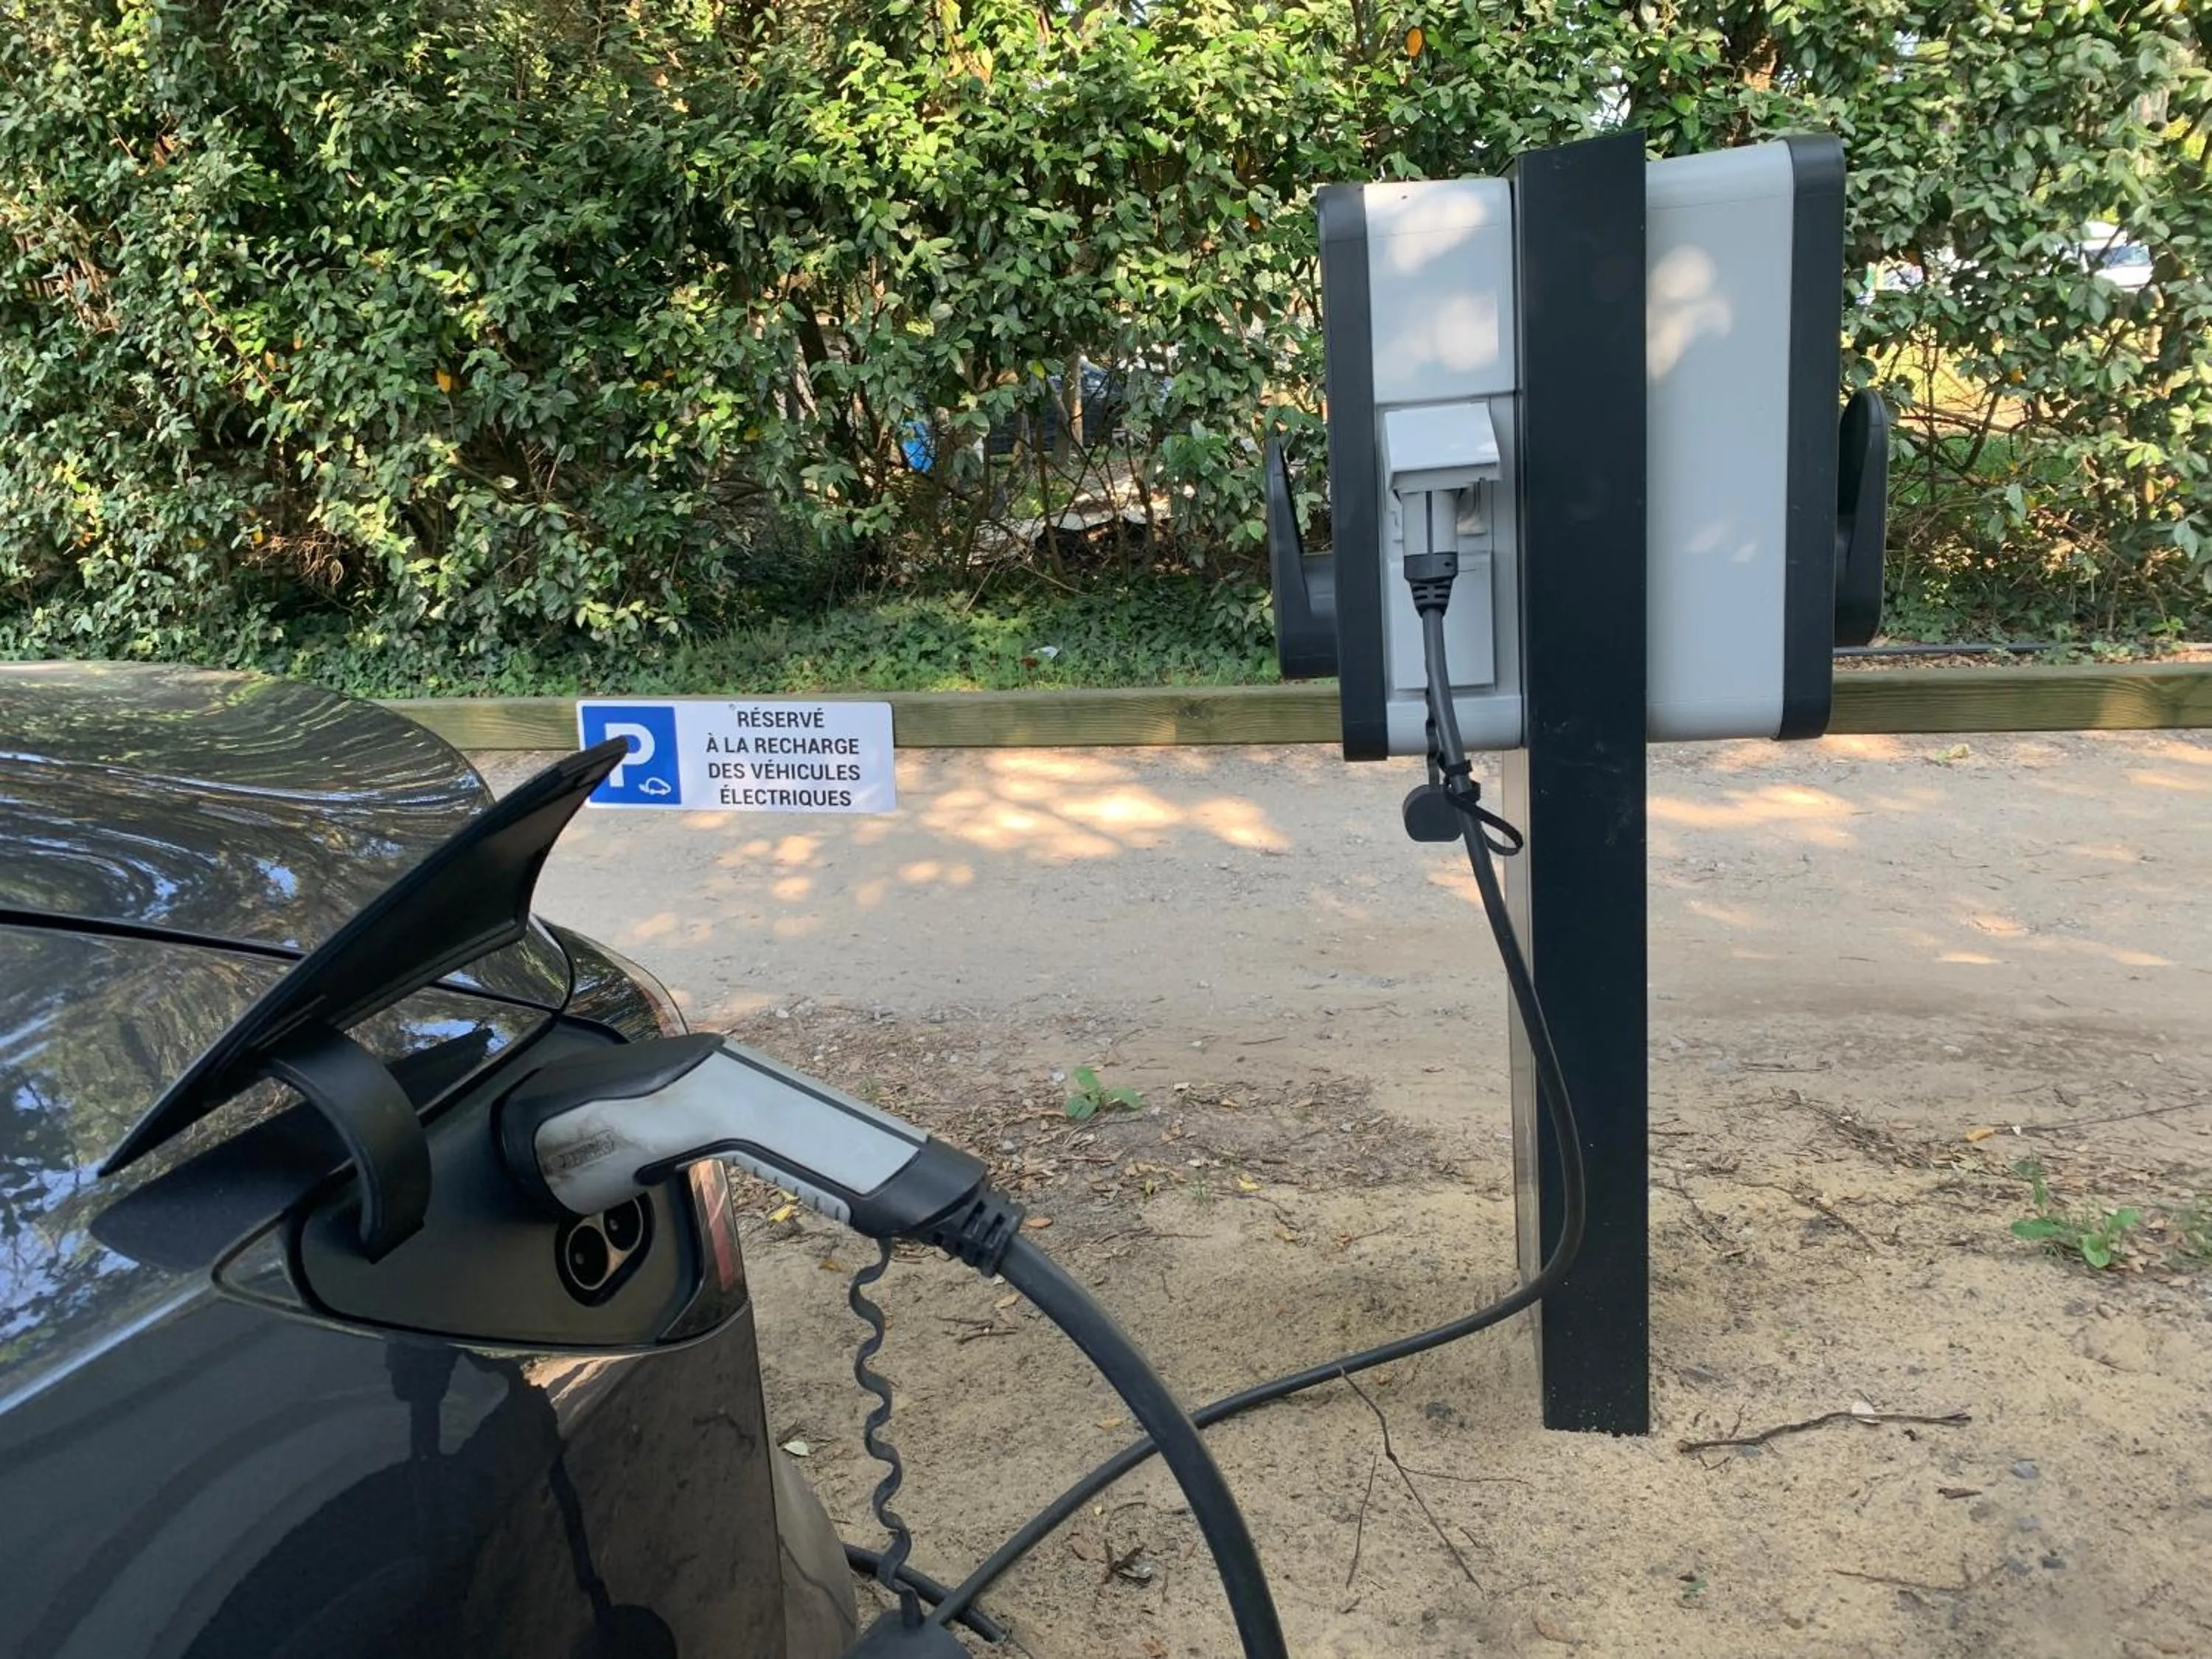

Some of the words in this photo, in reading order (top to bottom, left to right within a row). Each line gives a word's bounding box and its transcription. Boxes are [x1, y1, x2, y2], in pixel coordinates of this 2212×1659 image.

[737, 707, 825, 728] RÉSERVÉ
[605, 723, 655, 787] P
[706, 733, 719, 754] À
[725, 738, 749, 754] LA
[754, 738, 860, 756] RECHARGE
[708, 762, 745, 779] DES
[751, 759, 860, 782] VÉHICULES
[720, 784, 852, 807] ÉLECTRIQUES
